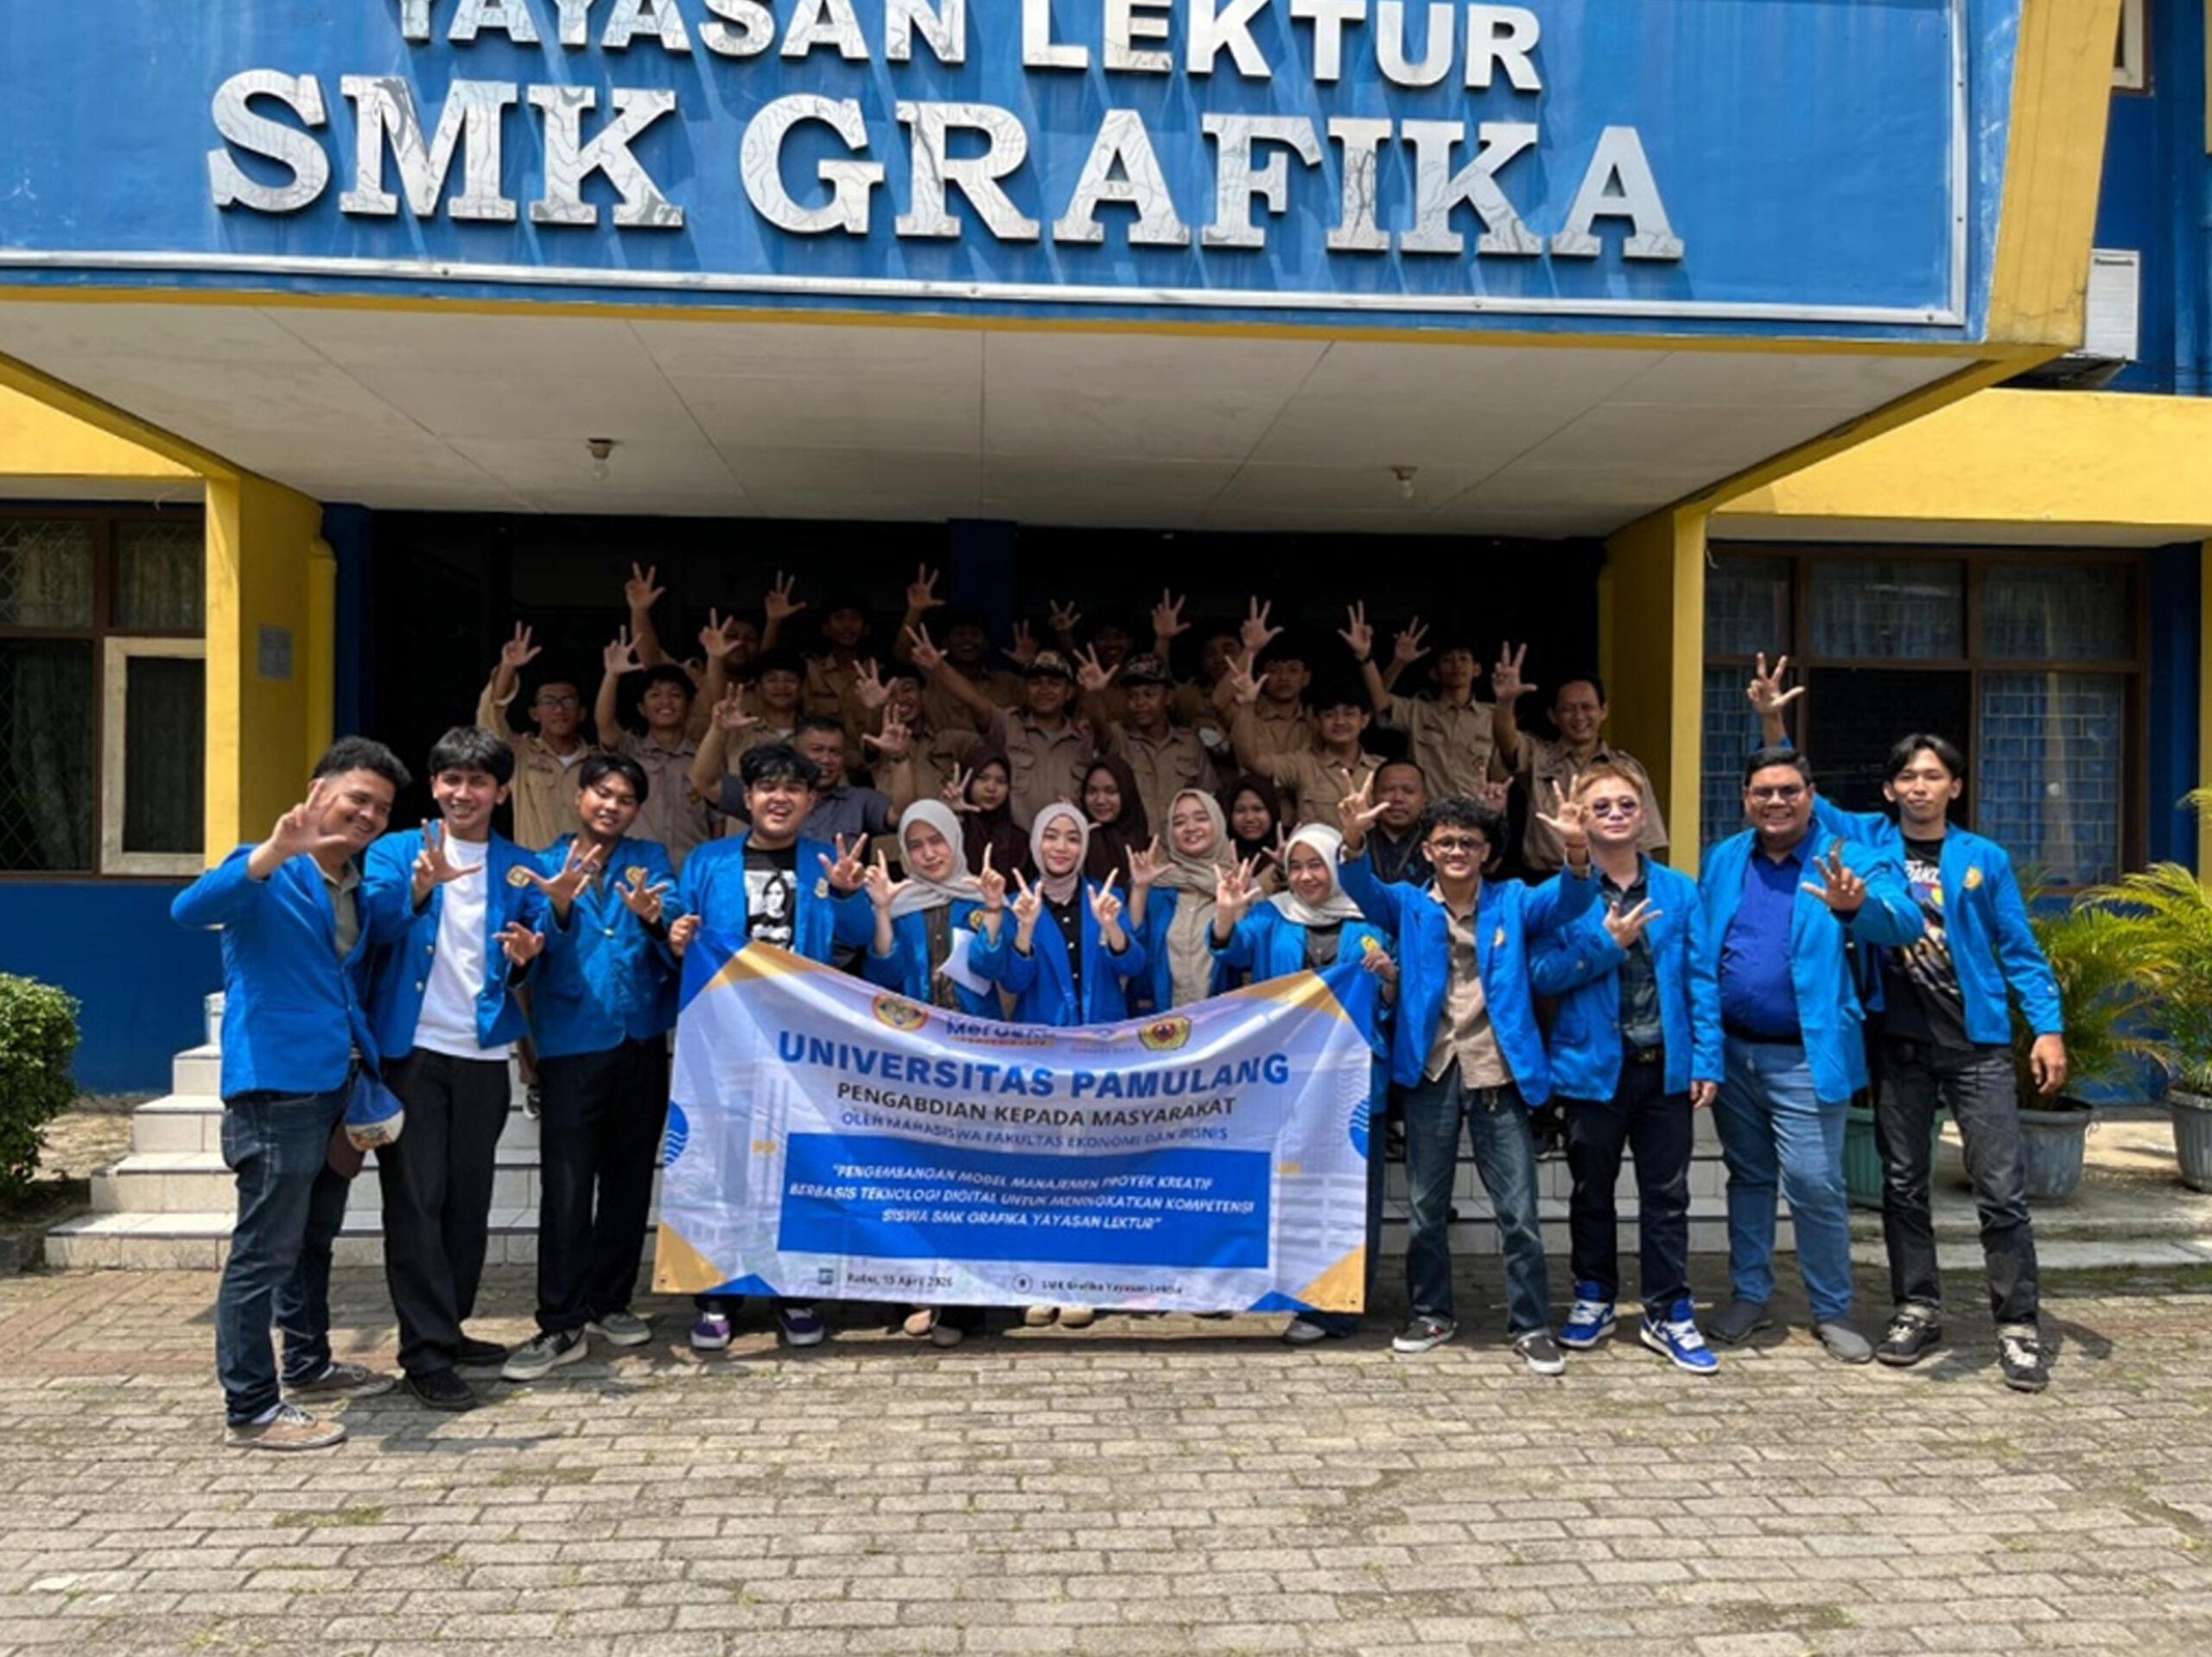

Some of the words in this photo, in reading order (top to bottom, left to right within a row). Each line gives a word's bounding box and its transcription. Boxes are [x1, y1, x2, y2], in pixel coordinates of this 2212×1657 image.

[1023, 0, 1541, 90] LEKTUR
[207, 69, 683, 227] SMK
[740, 93, 1684, 260] GRAFIKA
[779, 1031, 1054, 1097] UNIVERSITAS
[1071, 1053, 1288, 1099] PAMULANG
[837, 1082, 986, 1121] PENGABDIAN
[995, 1106, 1084, 1127] KEPADA
[1092, 1097, 1236, 1127] MASYARAKAT
[842, 1110, 881, 1127] OLEH
[886, 1117, 982, 1142] MAHASISWA
[984, 1127, 1063, 1148] FAKULTAS
[1067, 1131, 1141, 1148] EKONOMI
[1145, 1131, 1175, 1143] DAN
[1178, 1127, 1228, 1141] BISNIS
[789, 1183, 857, 1200] BERBASIS
[860, 1185, 941, 1203] TEKNOLOGI
[943, 1188, 997, 1203] DIGITAL
[1001, 1192, 1046, 1207] UNTUK
[1049, 1194, 1164, 1209] MENINGKATKAN
[1165, 1197, 1255, 1214] KOMPETENSI
[957, 1171, 1007, 1187] MODEL
[1010, 1177, 1100, 1190] MANAJEMEN
[1101, 1174, 1155, 1189] PROYEK
[1156, 1175, 1214, 1190] KREATIF
[881, 1208, 929, 1222] SISWA
[931, 1209, 964, 1223] SMK
[967, 1210, 1027, 1226] GRAFIKA
[1031, 1213, 1103, 1228] YAYASAN
